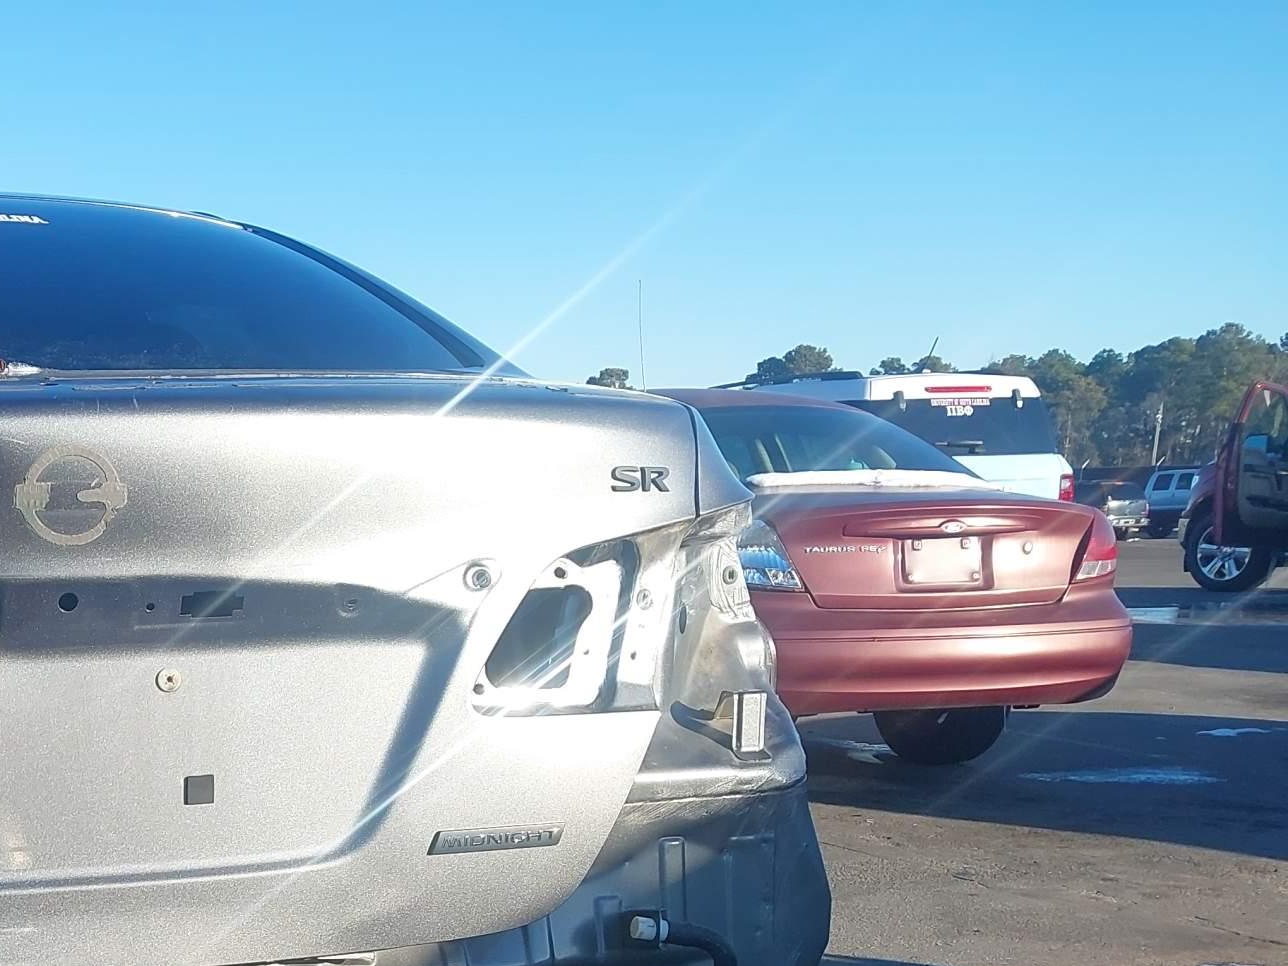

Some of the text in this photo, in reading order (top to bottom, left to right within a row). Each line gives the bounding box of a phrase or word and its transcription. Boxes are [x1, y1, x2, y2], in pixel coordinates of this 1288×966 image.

[610, 465, 670, 492] SR
[804, 545, 856, 554] TAURUS
[441, 830, 556, 849] MIDNIGHT
